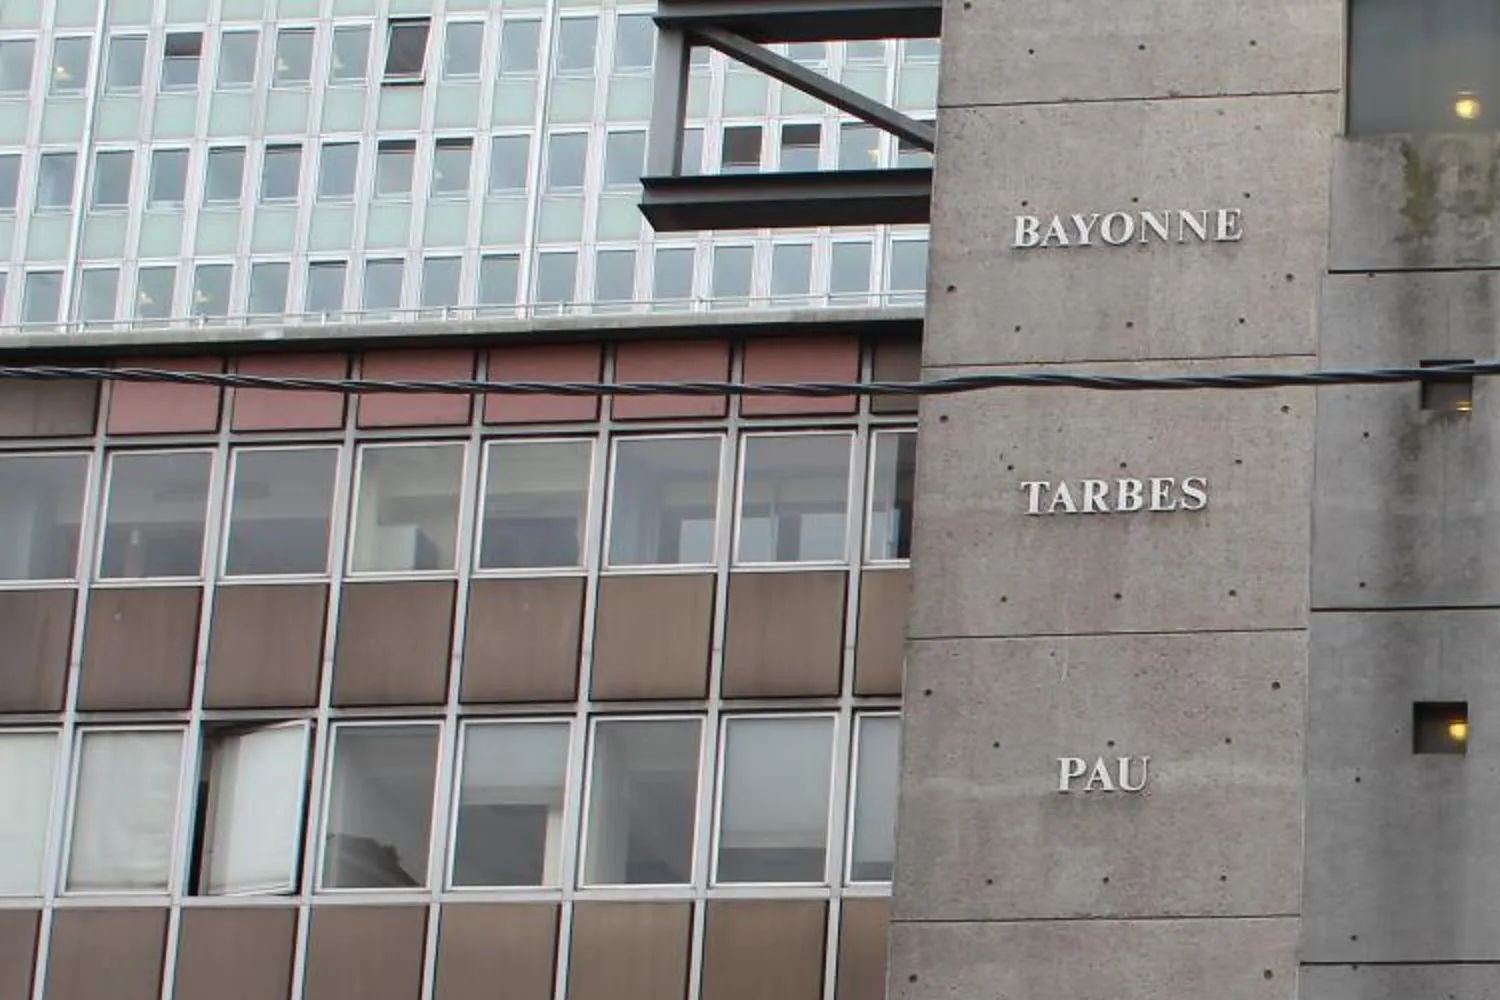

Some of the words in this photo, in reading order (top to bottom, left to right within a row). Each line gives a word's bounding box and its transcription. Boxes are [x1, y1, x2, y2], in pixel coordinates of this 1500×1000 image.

[1014, 207, 1242, 247] BAYONNE
[1021, 477, 1208, 514] TARBES
[1058, 756, 1149, 792] PAU
